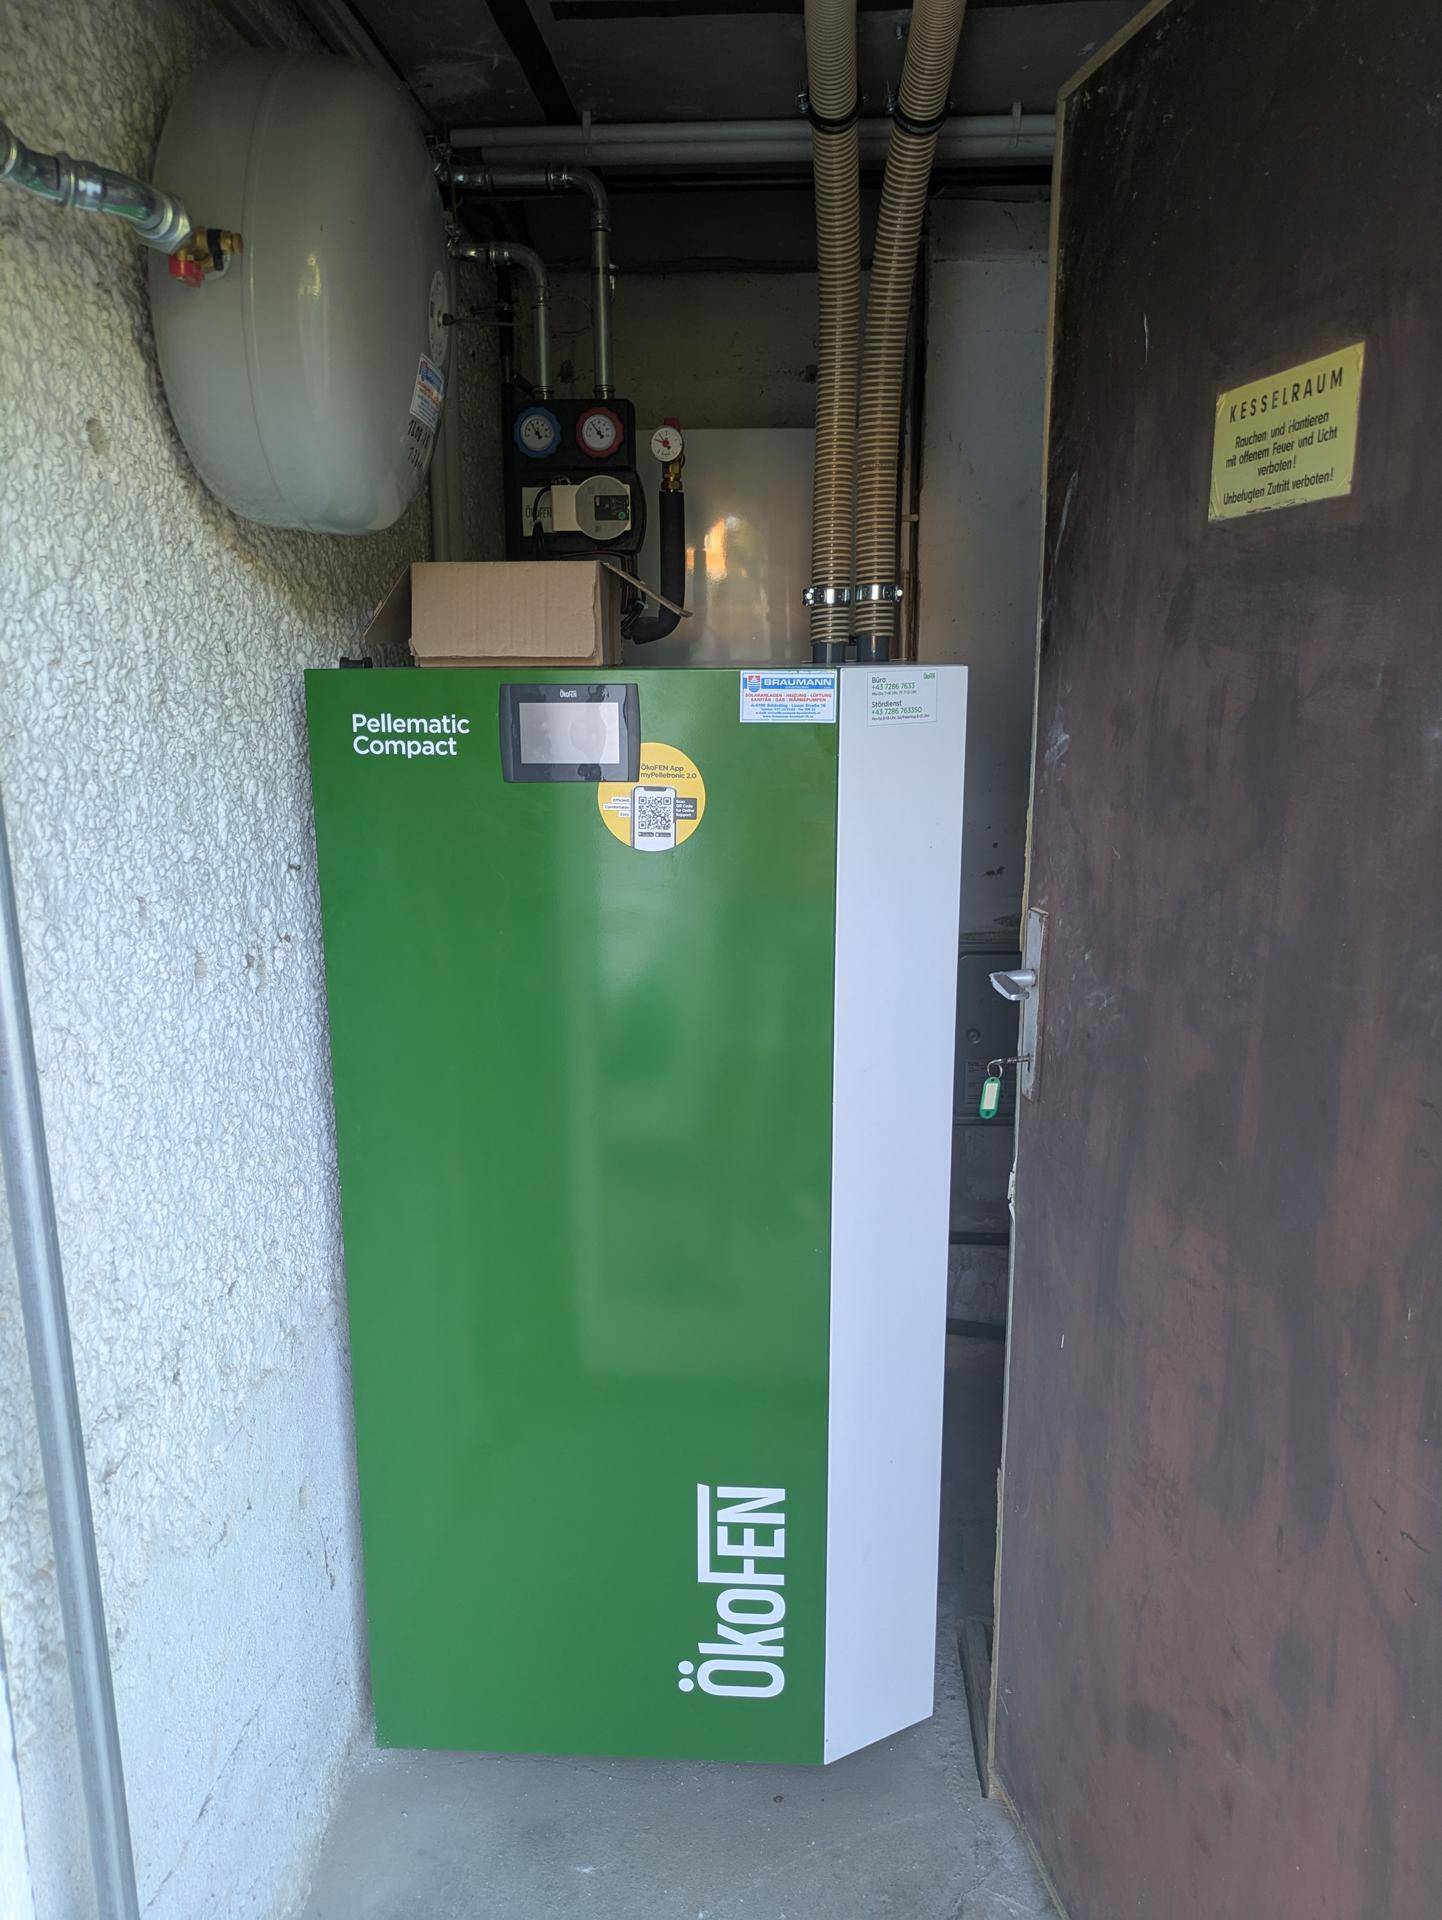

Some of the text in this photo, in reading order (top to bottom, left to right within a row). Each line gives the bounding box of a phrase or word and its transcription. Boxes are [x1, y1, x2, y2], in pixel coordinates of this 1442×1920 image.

[1229, 367, 1343, 423] KESSELRAUM
[1235, 412, 1329, 448] Rauchen und Hantieren
[1226, 426, 1338, 468] mit offenem Feuer und Licht
[1257, 455, 1297, 476] verboten!
[1223, 468, 1334, 504] Unbefugten Zutritt verboten!
[871, 700, 902, 708] Stördienst
[352, 713, 470, 734] Pellematic
[353, 735, 458, 759] Compact
